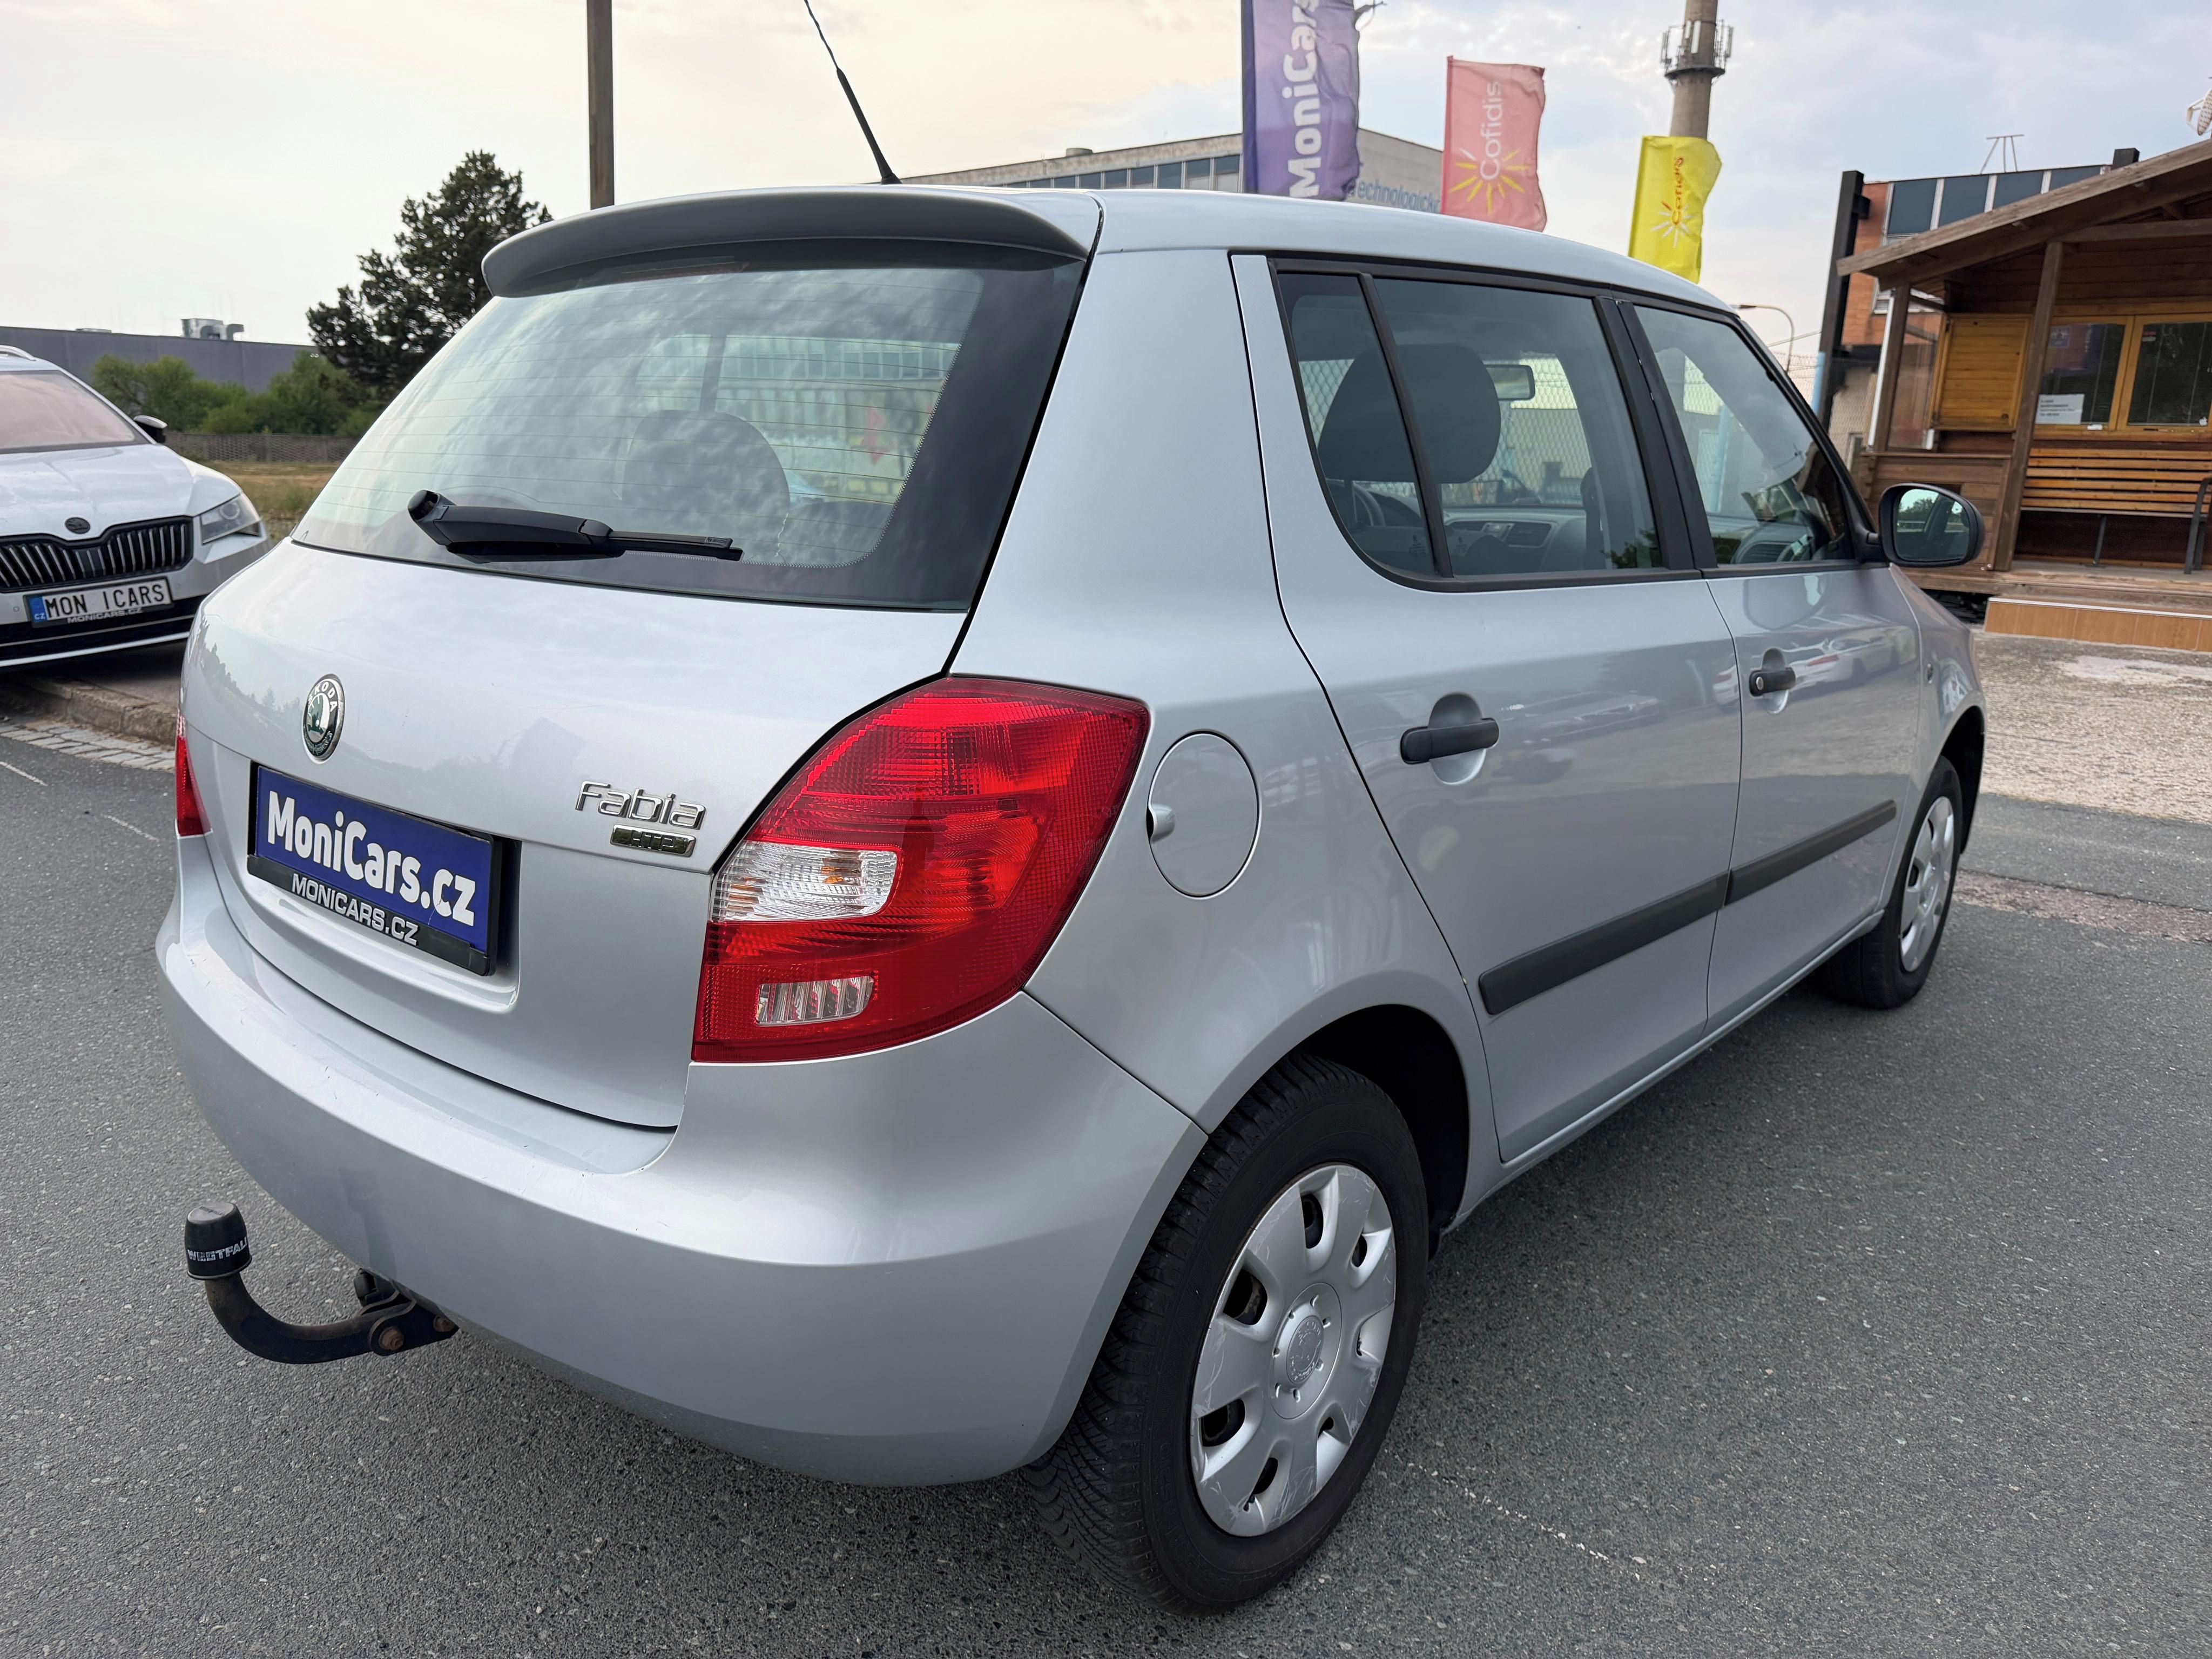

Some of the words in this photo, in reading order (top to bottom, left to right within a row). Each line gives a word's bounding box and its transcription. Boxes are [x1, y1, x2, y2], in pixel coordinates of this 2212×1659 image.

[1480, 82, 1502, 180] Cofidis
[45, 595, 87, 618] MON
[67, 608, 143, 624] MONICARS.CZ
[575, 781, 706, 830] Fabia
[268, 791, 476, 926] MoniCars.cz
[631, 830, 675, 851] HTP
[292, 873, 419, 946] MONICARS.CZ
